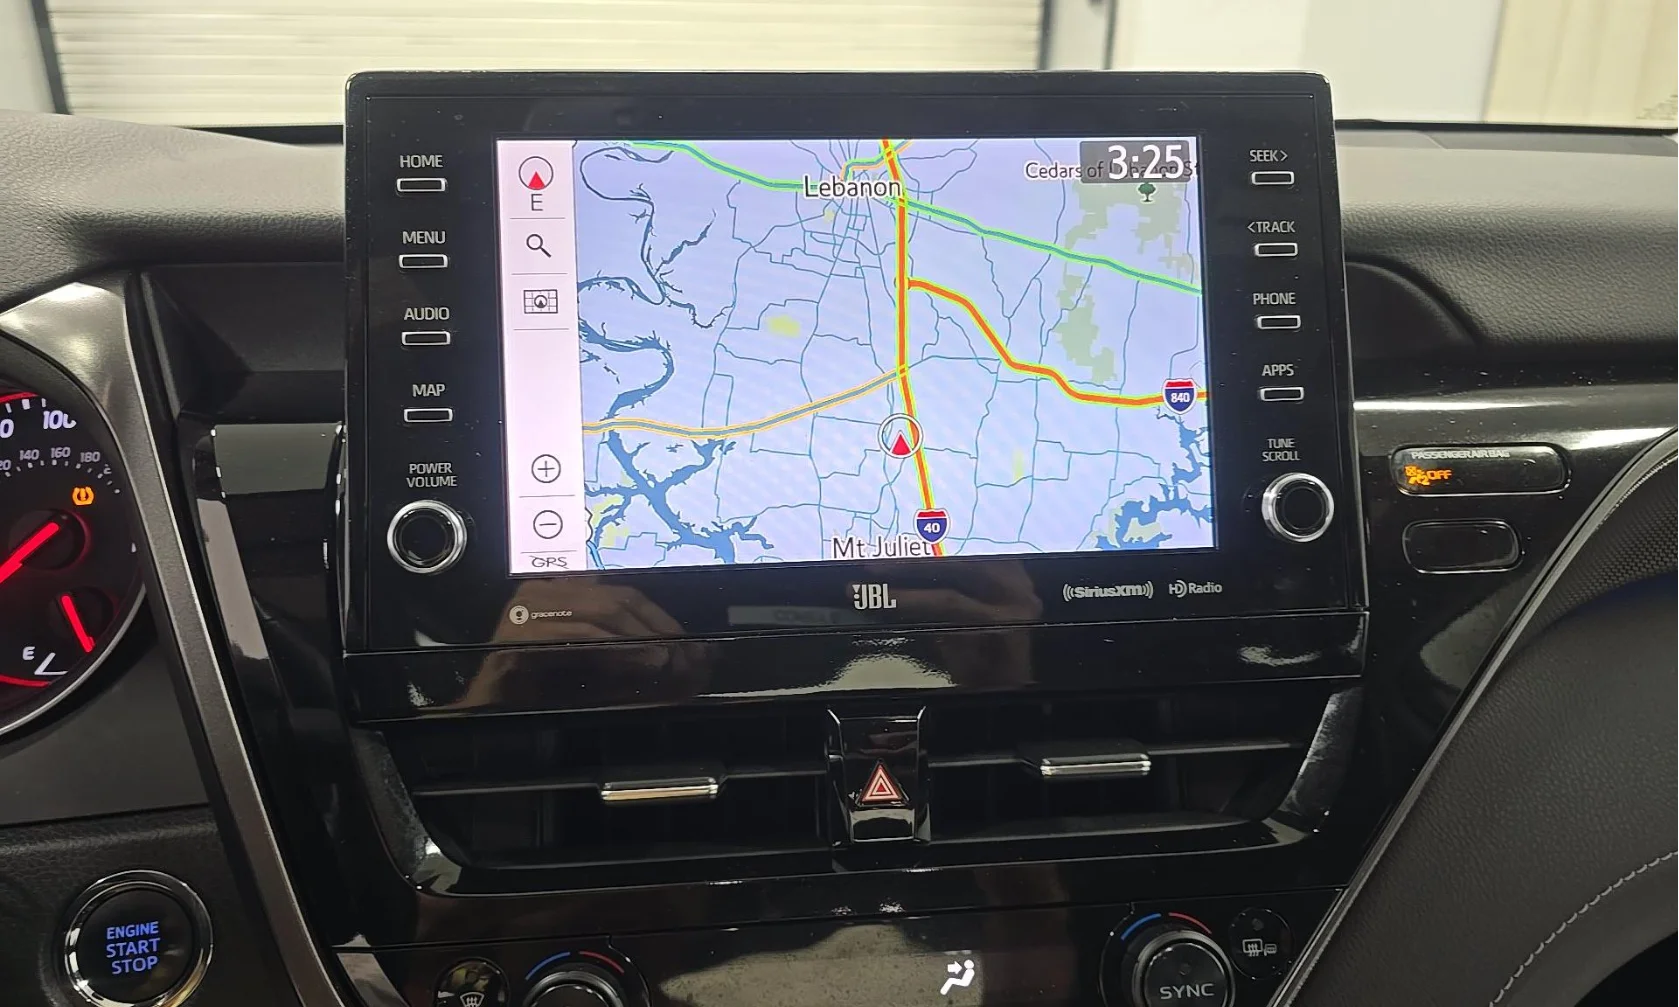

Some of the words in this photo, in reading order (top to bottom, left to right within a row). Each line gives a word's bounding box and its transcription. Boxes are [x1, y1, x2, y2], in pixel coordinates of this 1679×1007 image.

[400, 154, 443, 168] HOME
[1108, 144, 1184, 180] 3:25
[1026, 162, 1082, 179] Cedars
[1087, 161, 1104, 178] of
[804, 175, 901, 197] Lebanon
[531, 193, 543, 211] E
[402, 231, 446, 244] MENU
[1253, 292, 1296, 305] PHONE
[403, 307, 450, 321] AUDIO
[1262, 364, 1294, 376] APPS
[412, 384, 446, 397] MAP
[1171, 392, 1190, 403] 840
[1267, 438, 1296, 448] TUNE
[19, 449, 40, 460] 140
[50, 446, 71, 458] 160
[80, 451, 101, 462] 180
[1262, 450, 1301, 462] SCROLL
[1411, 450, 1471, 459] PASSENGER
[1472, 450, 1488, 458] AIR
[1489, 449, 1510, 458] BAG
[409, 463, 452, 475] POWER
[1426, 469, 1453, 480] OFF
[406, 476, 458, 488] VOLUME
[923, 522, 941, 534] 40
[832, 536, 865, 559] Mt
[872, 534, 931, 557] Juliet
[1188, 582, 1223, 594] Radio
[853, 583, 897, 610] JBL
[530, 611, 573, 620] gracenote
[22, 646, 36, 661] E
[106, 921, 159, 940] ENGINE
[106, 938, 161, 958] START
[111, 955, 158, 975] STOP
[1159, 983, 1215, 1000] SYNC
